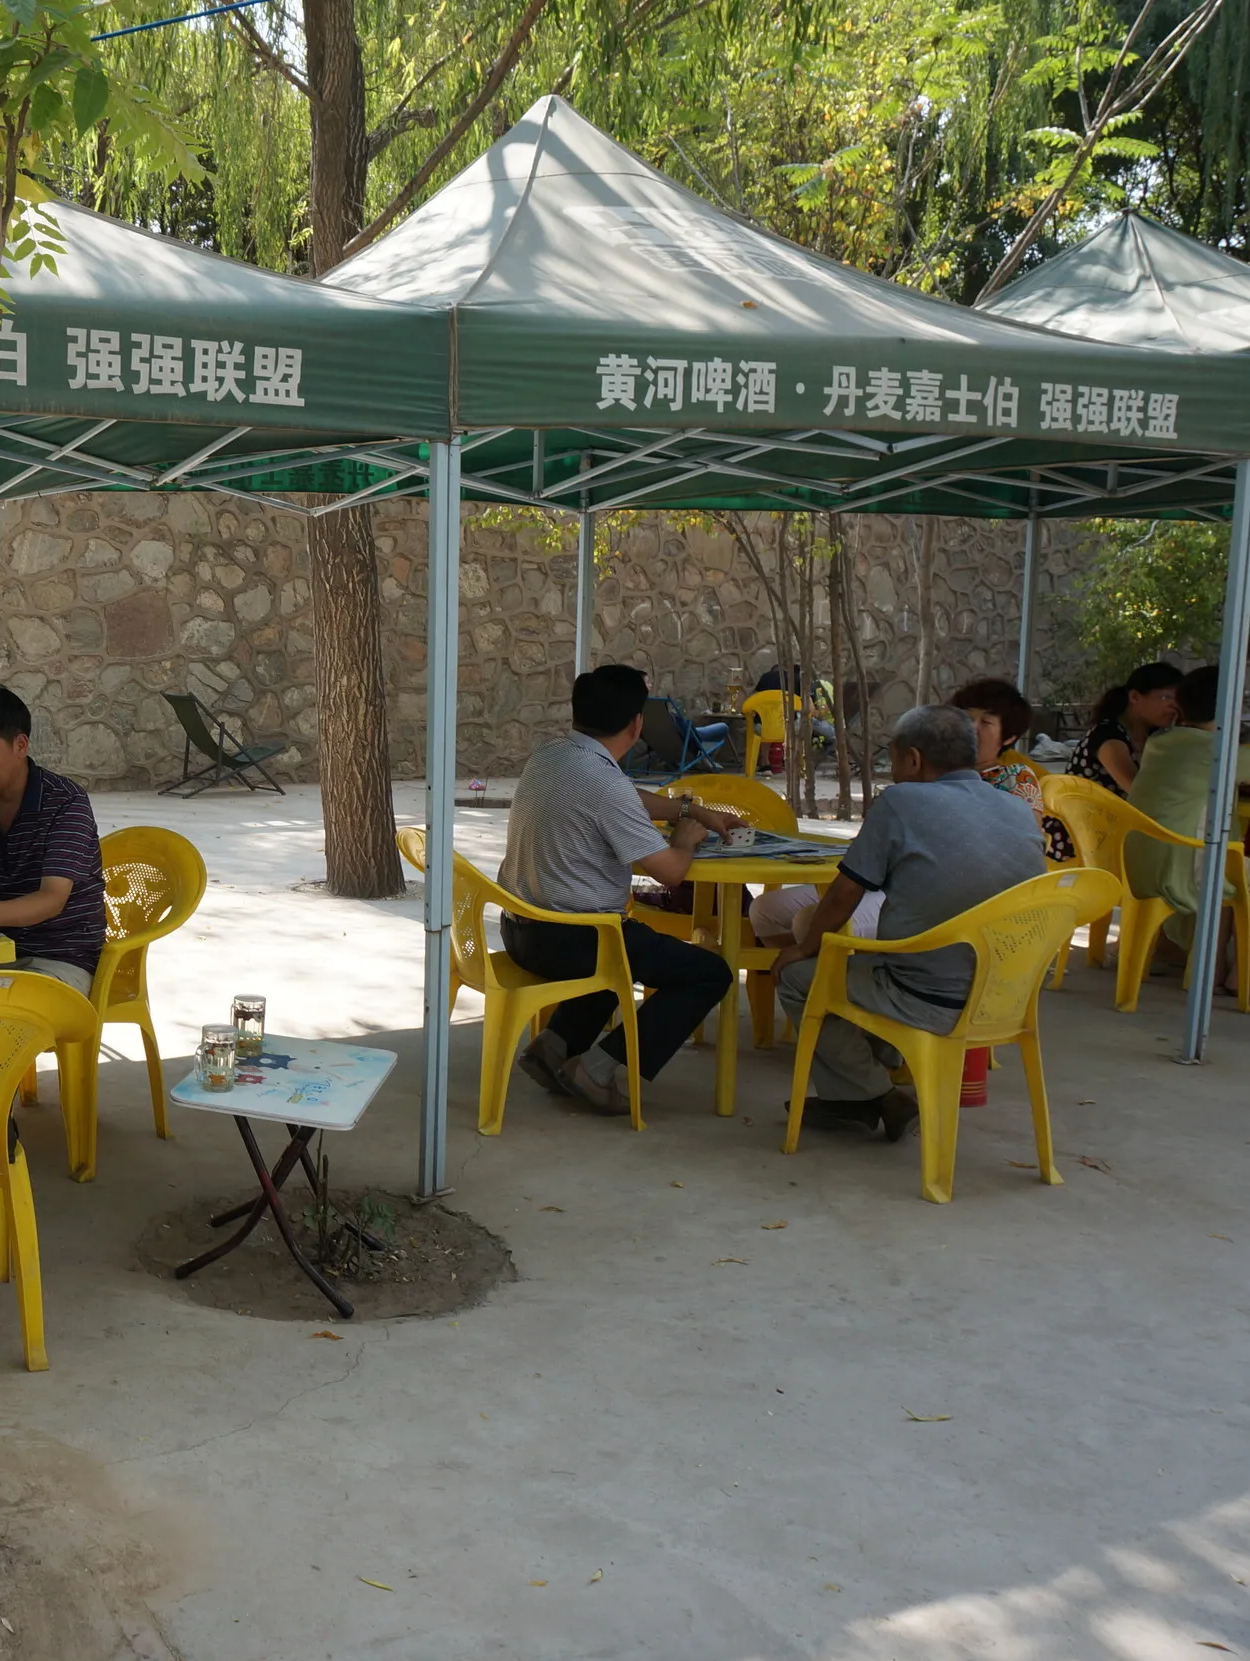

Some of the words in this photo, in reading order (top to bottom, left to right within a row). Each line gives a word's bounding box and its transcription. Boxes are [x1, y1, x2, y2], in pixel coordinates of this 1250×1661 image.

[66, 327, 305, 407] 强强联盟
[1040, 382, 1179, 439] 强强联盟
